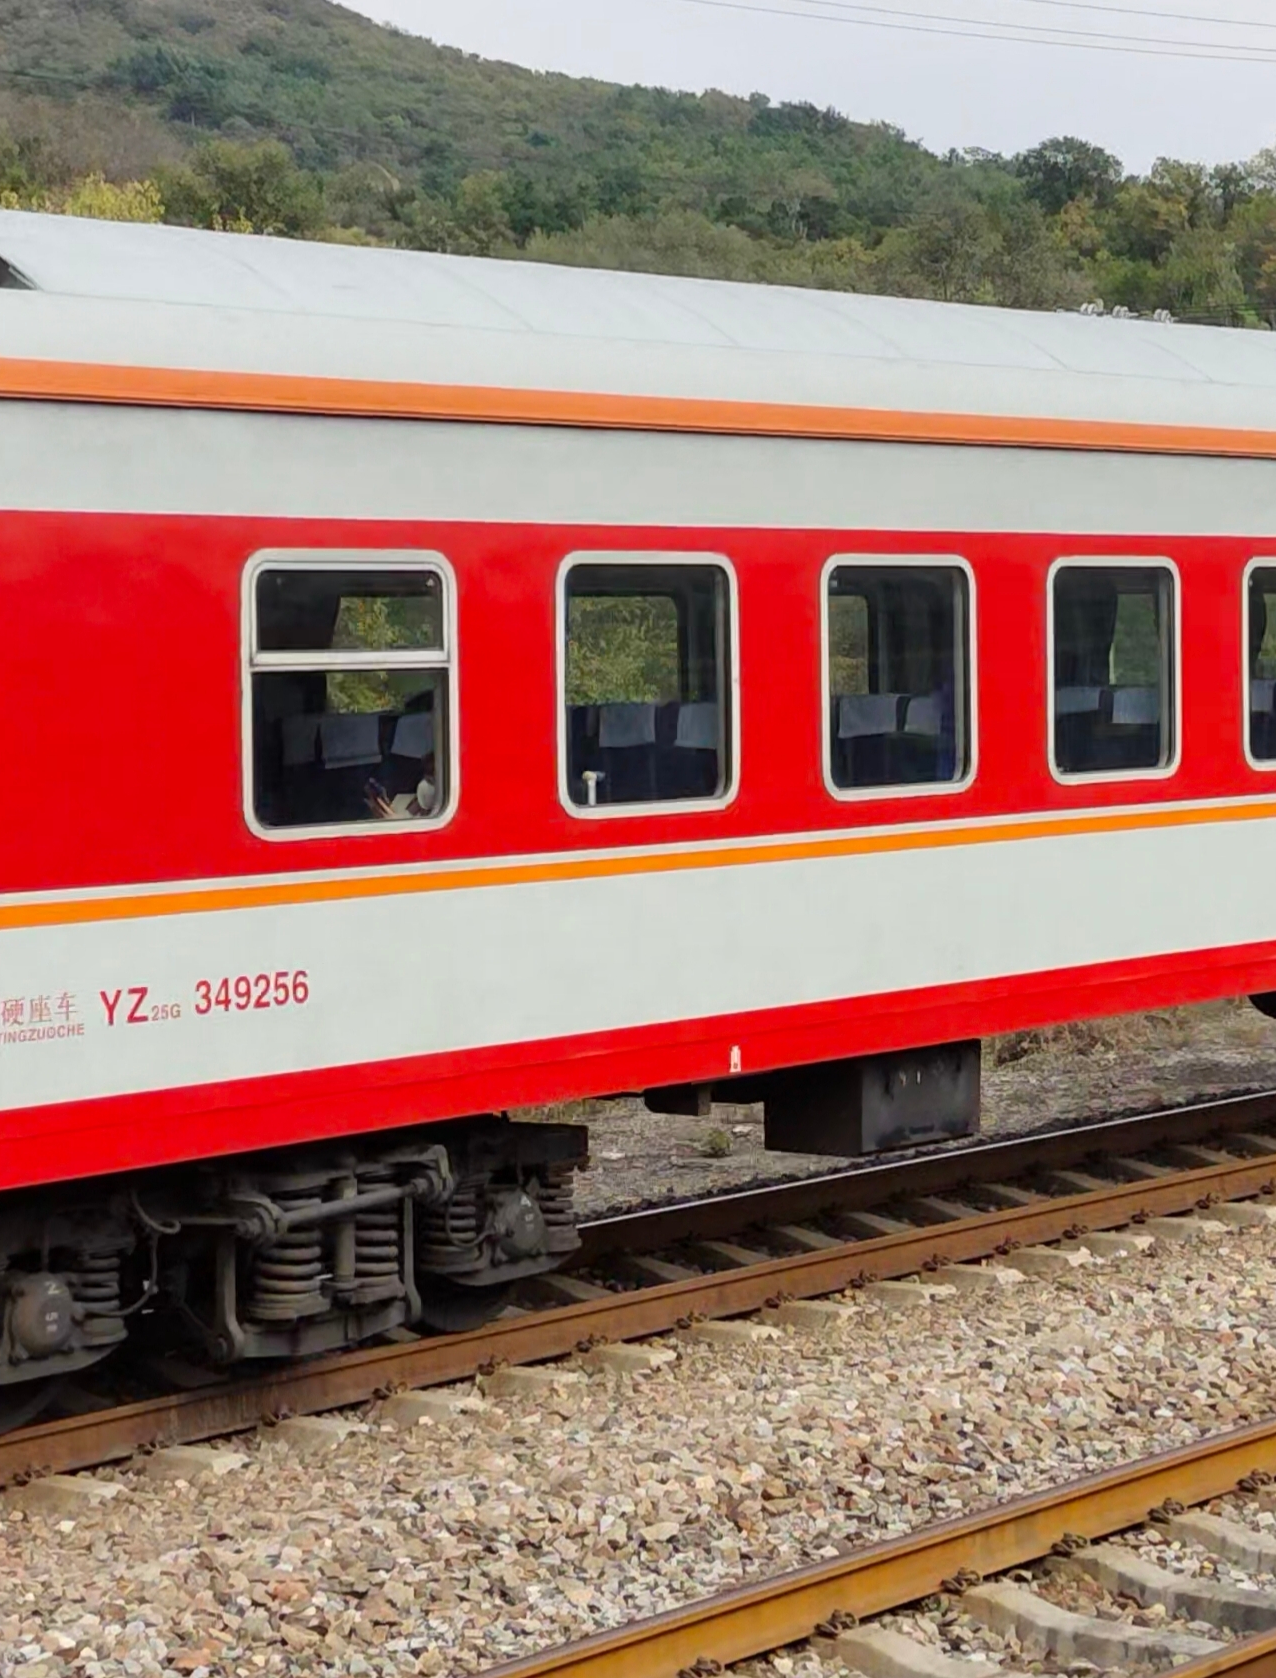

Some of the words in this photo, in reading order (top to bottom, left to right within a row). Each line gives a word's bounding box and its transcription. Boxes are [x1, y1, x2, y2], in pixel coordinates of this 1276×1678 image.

[1, 991, 79, 1026] 硬座车
[194, 970, 310, 1015] 349256
